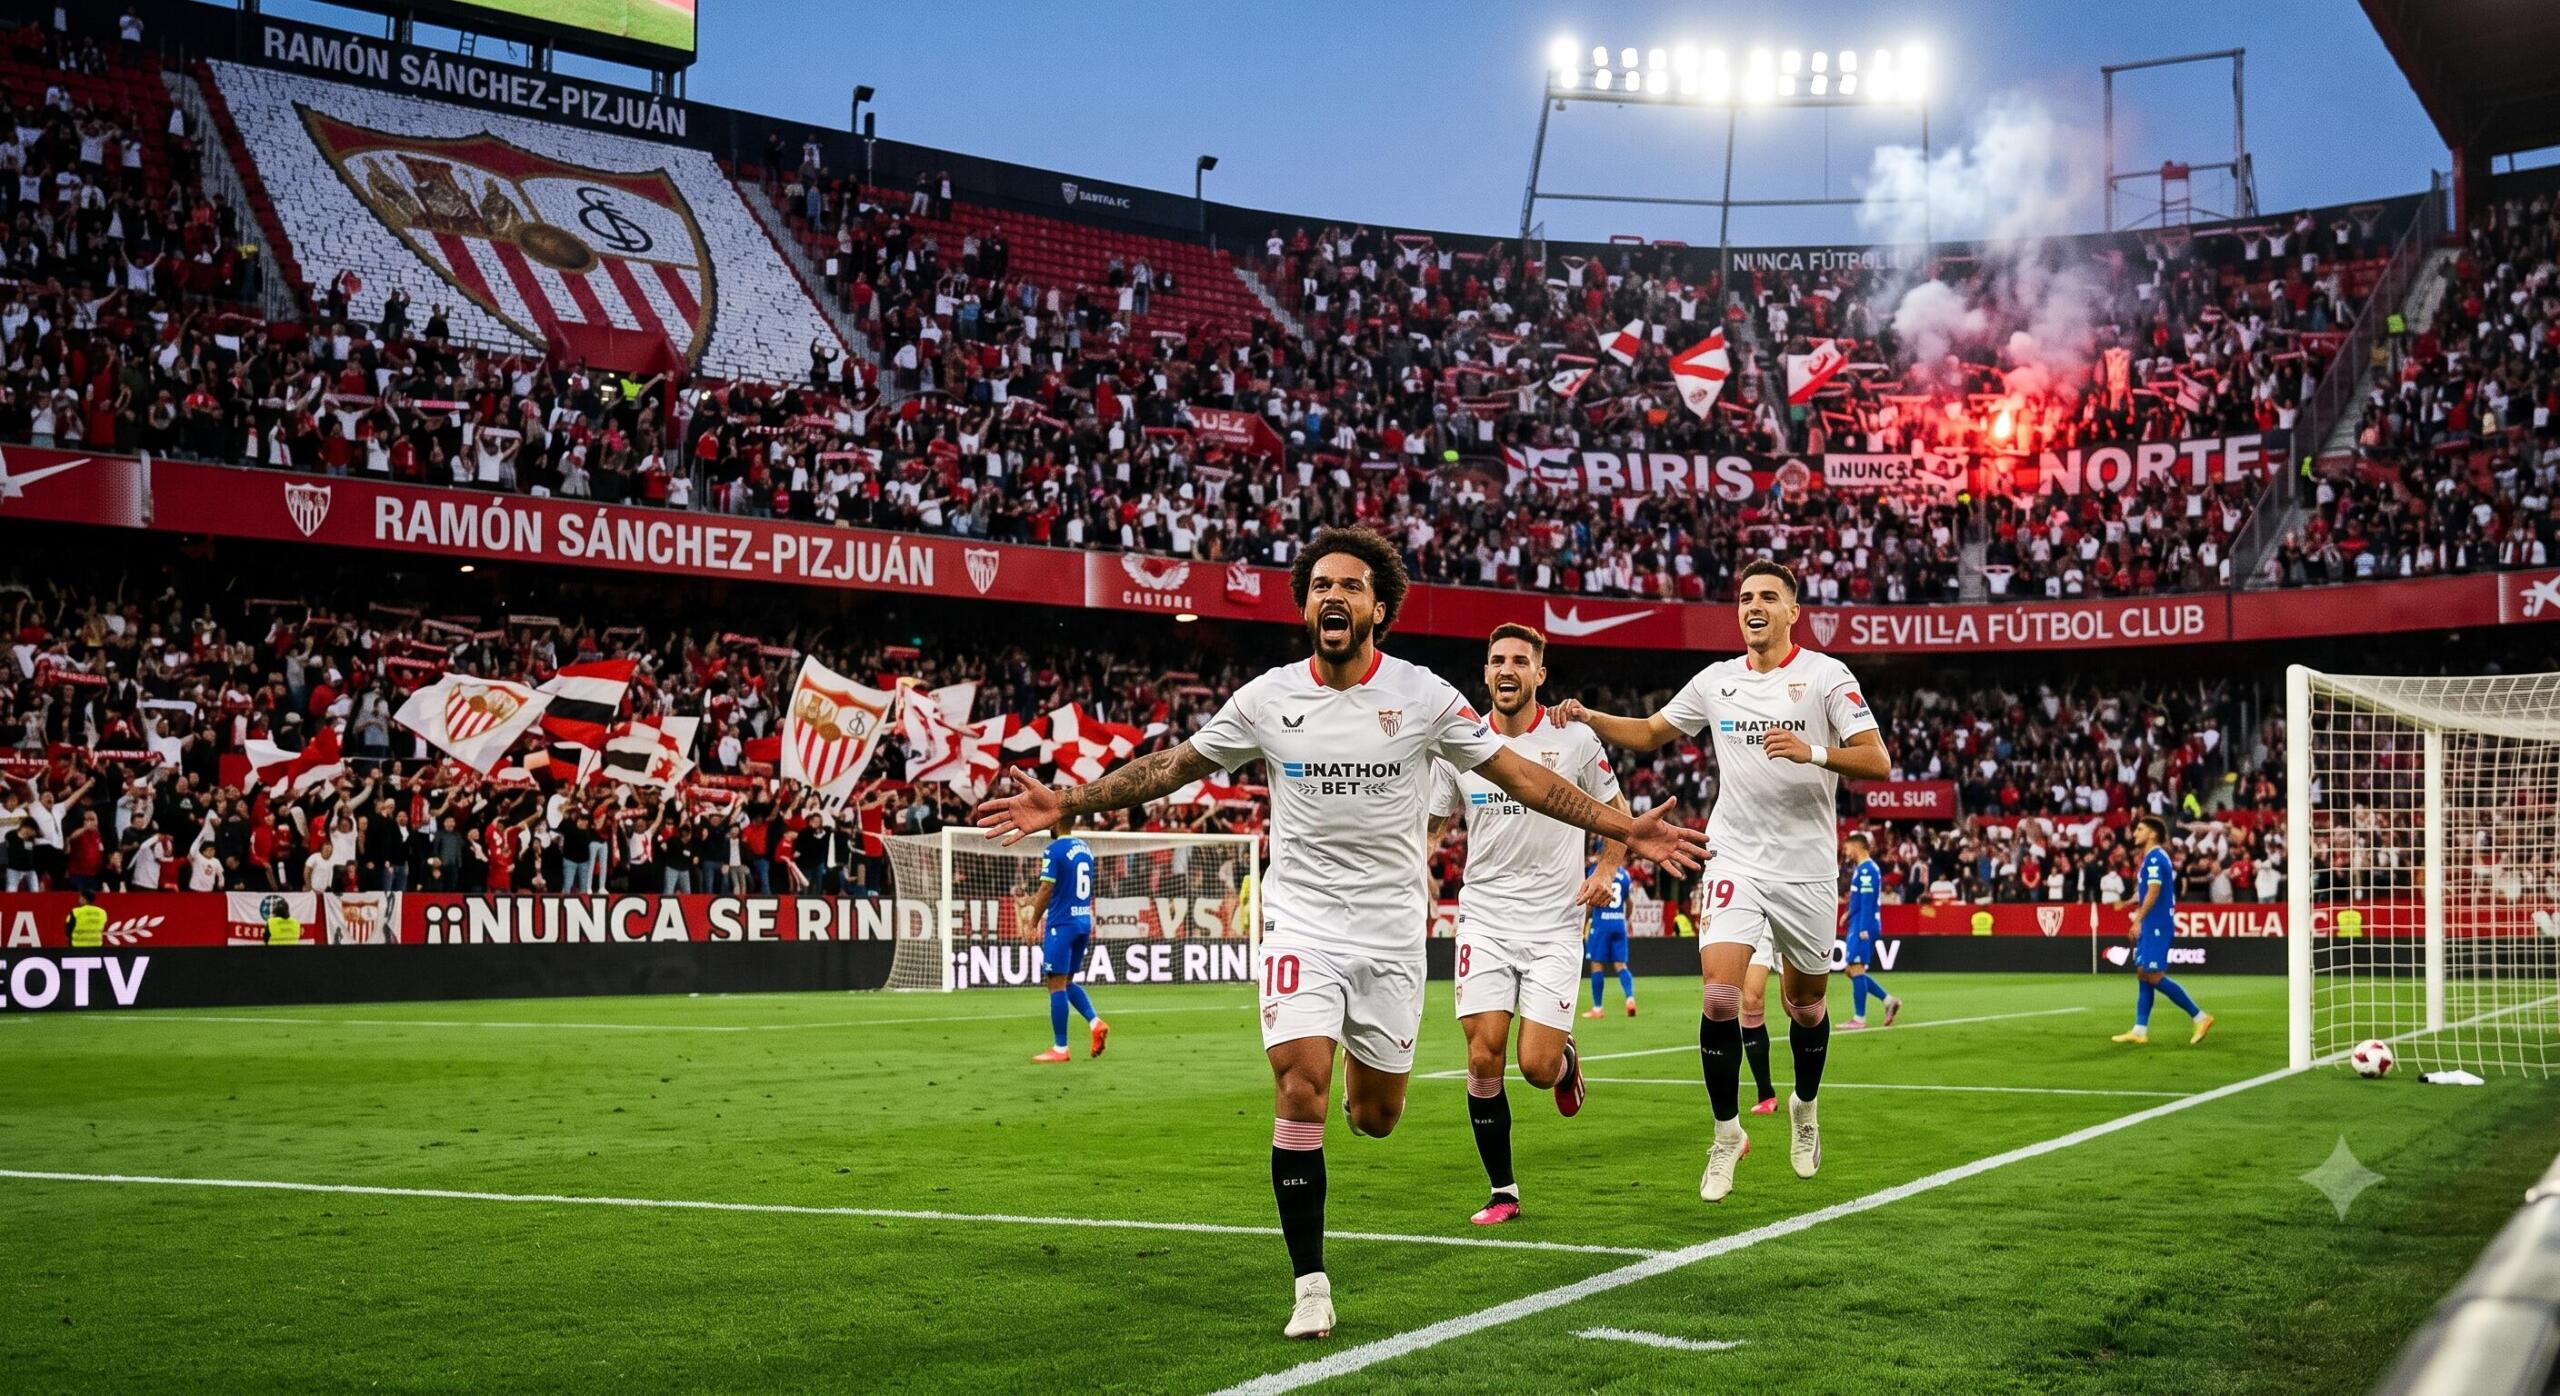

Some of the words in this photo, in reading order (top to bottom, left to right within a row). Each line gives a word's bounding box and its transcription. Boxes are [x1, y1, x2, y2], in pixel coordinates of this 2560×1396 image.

[264, 26, 389, 80] RAMÓN
[400, 52, 686, 137] SÁNCHEZ-PIZJUÁN
[1733, 251, 1804, 271] NUNCA
[1582, 452, 1754, 501] BIRIS
[2038, 434, 2262, 496] NORTE
[375, 496, 542, 553] RAMÓN
[557, 508, 934, 587] SÁNCHEZ-PIZJUÁN
[1122, 590, 1193, 609] CASTORE
[1850, 612, 1979, 645] SEVILLA
[1987, 607, 2113, 643] FÚTBOL
[2119, 604, 2205, 638] CLUB
[1746, 735, 1764, 745] BE
[1322, 782, 1361, 795] BET
[1866, 791, 1900, 807] GOL
[1903, 791, 1937, 807] SUR
[1076, 861, 1091, 900] 6
[1705, 880, 1735, 909] 19
[0, 911, 42, 948] A
[709, 897, 779, 942] SE
[2174, 911, 2284, 938] SEVILLA
[0, 956, 150, 1009] OTV
[1126, 944, 1173, 983] SE
[1264, 954, 1300, 997] 10
